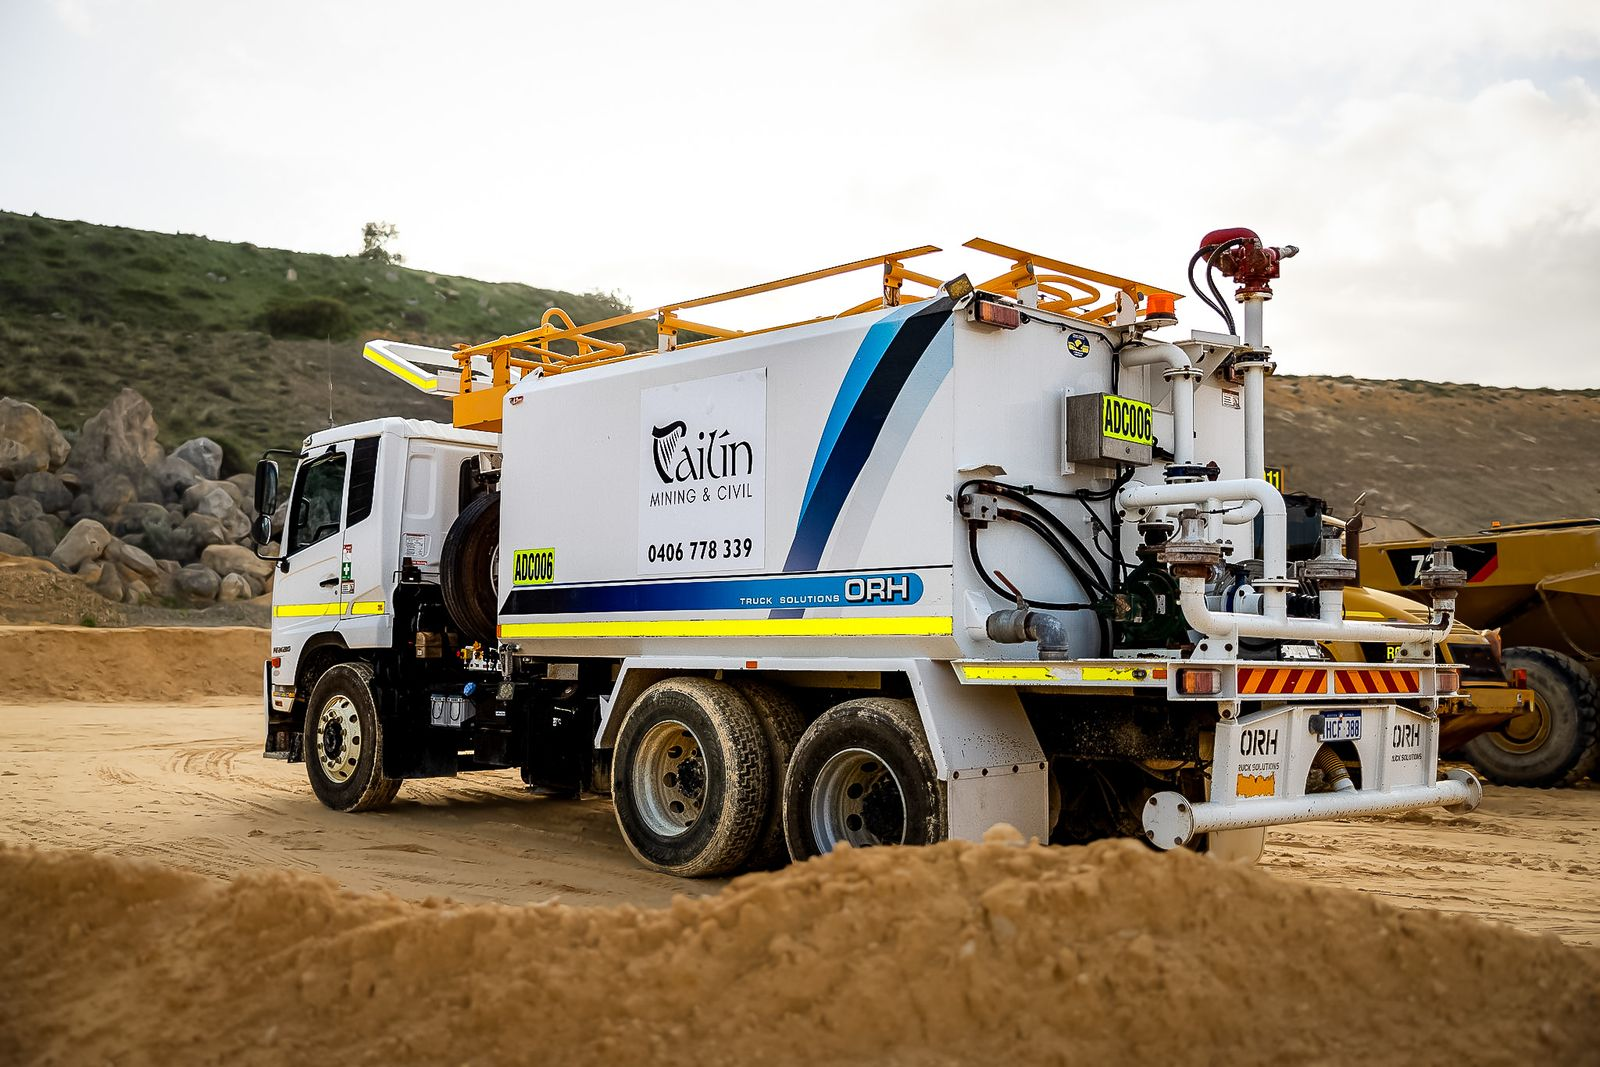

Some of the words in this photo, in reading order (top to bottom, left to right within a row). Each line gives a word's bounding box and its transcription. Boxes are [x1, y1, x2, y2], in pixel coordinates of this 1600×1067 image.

[1104, 398, 1151, 441] ADC006
[650, 489, 697, 507] MINING
[702, 487, 711, 502] &
[717, 483, 753, 501] CIVIL
[648, 543, 684, 563] 0406
[689, 540, 717, 560] 778
[722, 537, 753, 559] 339
[514, 551, 553, 581] ADC006
[739, 597, 773, 605] TRUCK
[779, 594, 840, 604] SOLUTIONS
[844, 576, 910, 603] ORH
[1323, 720, 1342, 739] HCF
[1346, 719, 1359, 737] 388
[1392, 723, 1421, 748] ORH
[1240, 729, 1279, 756] ORH
[1252, 762, 1279, 771] SOLUTIONS
